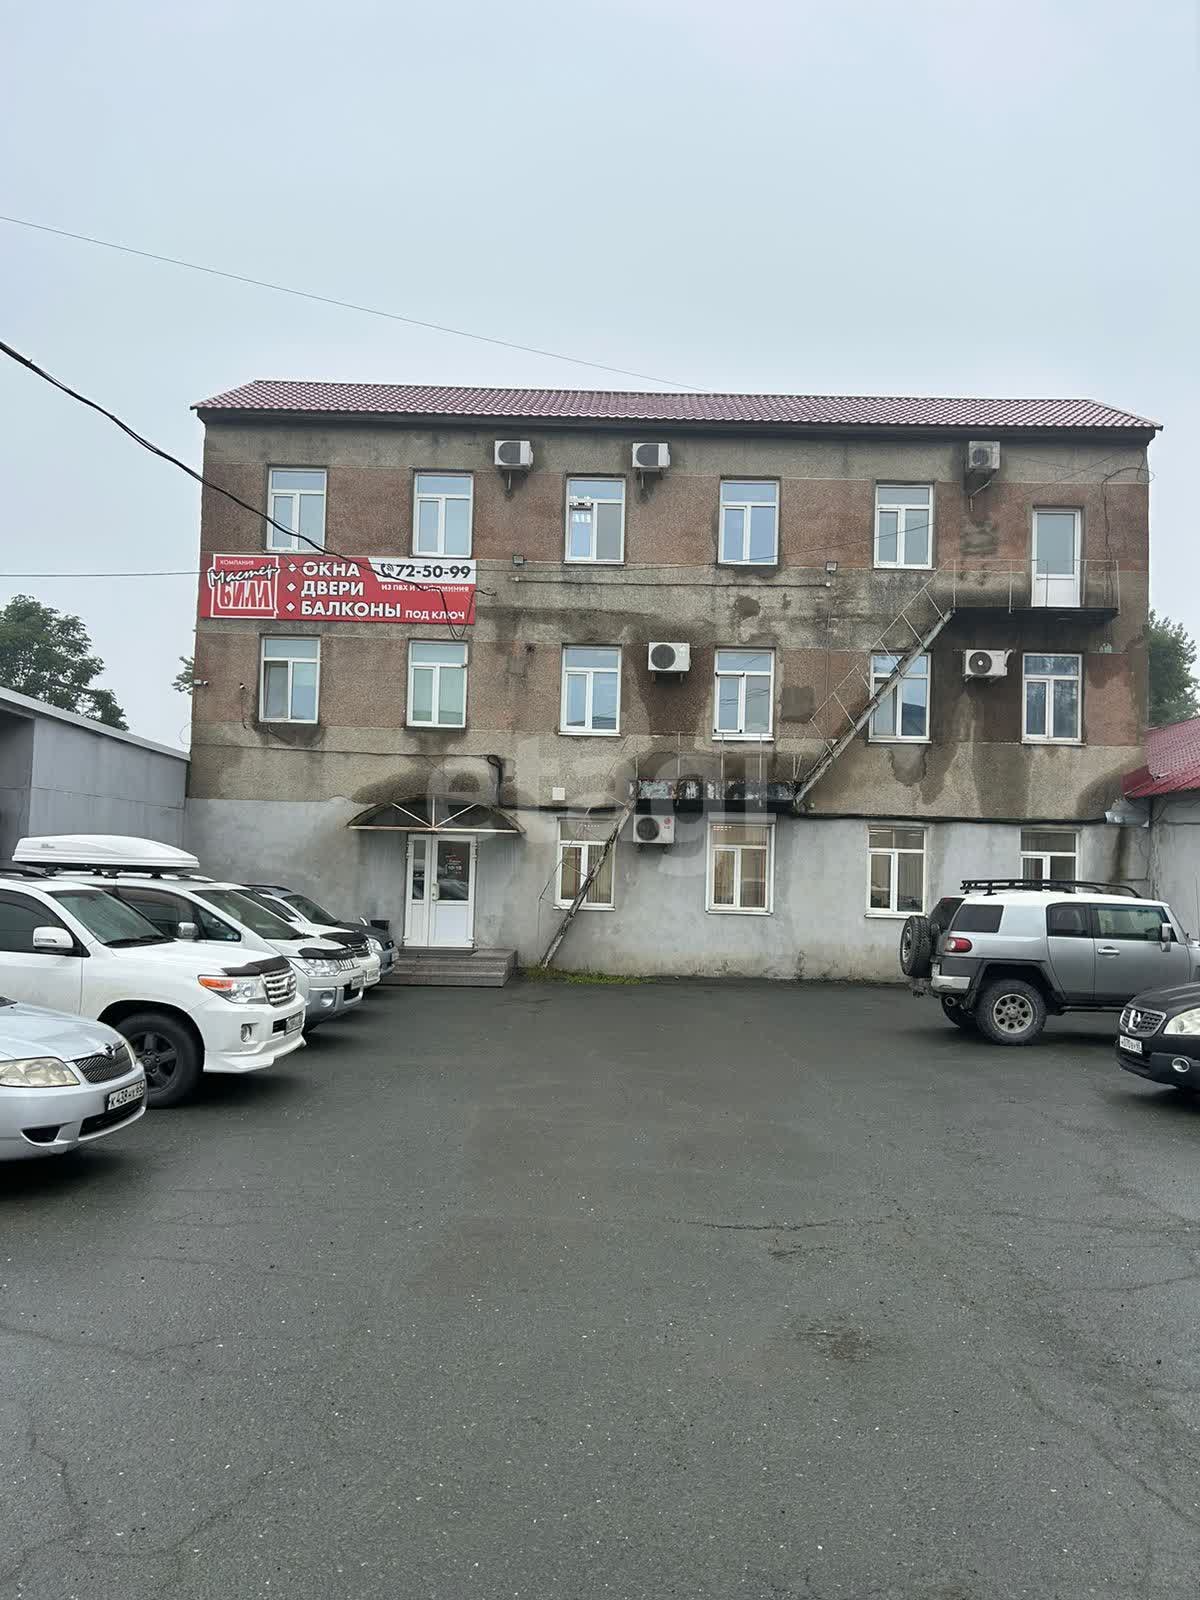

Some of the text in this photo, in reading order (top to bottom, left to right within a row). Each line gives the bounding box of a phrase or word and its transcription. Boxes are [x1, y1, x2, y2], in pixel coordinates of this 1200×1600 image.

[302, 561, 360, 577] ОКНА
[395, 564, 471, 579] 72-50-99
[300, 580, 364, 597] ДВЕРИ
[301, 601, 401, 618] БАЛКОНЫ
[405, 610, 465, 620] ПОД КЛЮЧ
